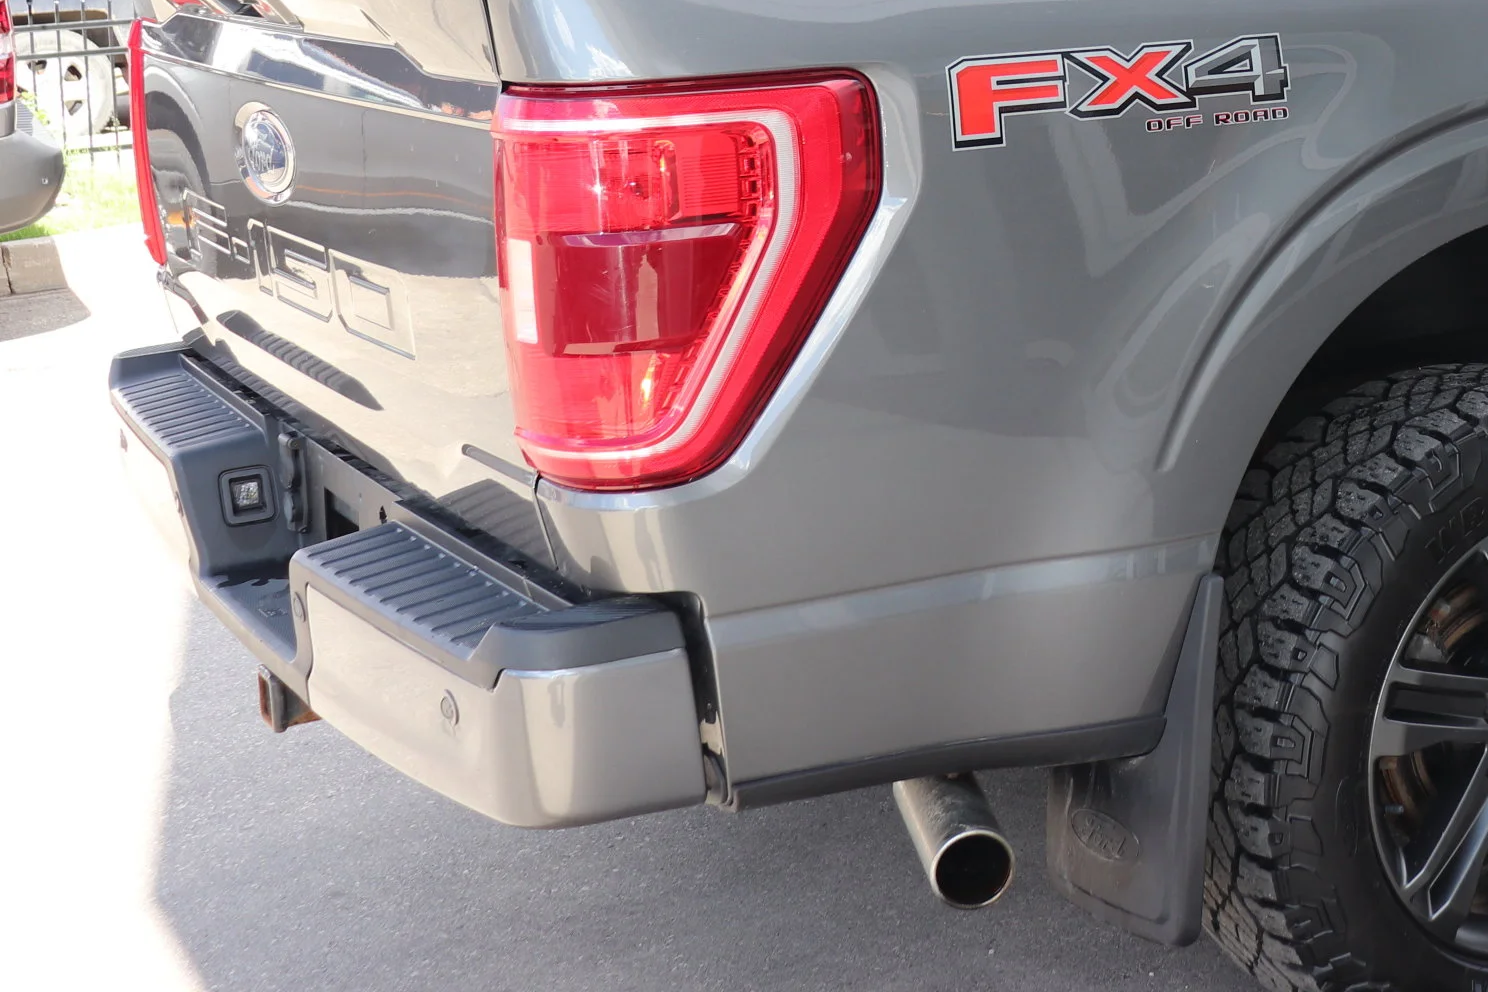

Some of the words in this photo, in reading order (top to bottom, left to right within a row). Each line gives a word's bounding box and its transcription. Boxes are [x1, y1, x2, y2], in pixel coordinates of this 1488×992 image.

[945, 32, 1291, 151] FX4
[1145, 114, 1203, 132] OFF
[1213, 107, 1290, 126] ROAD
